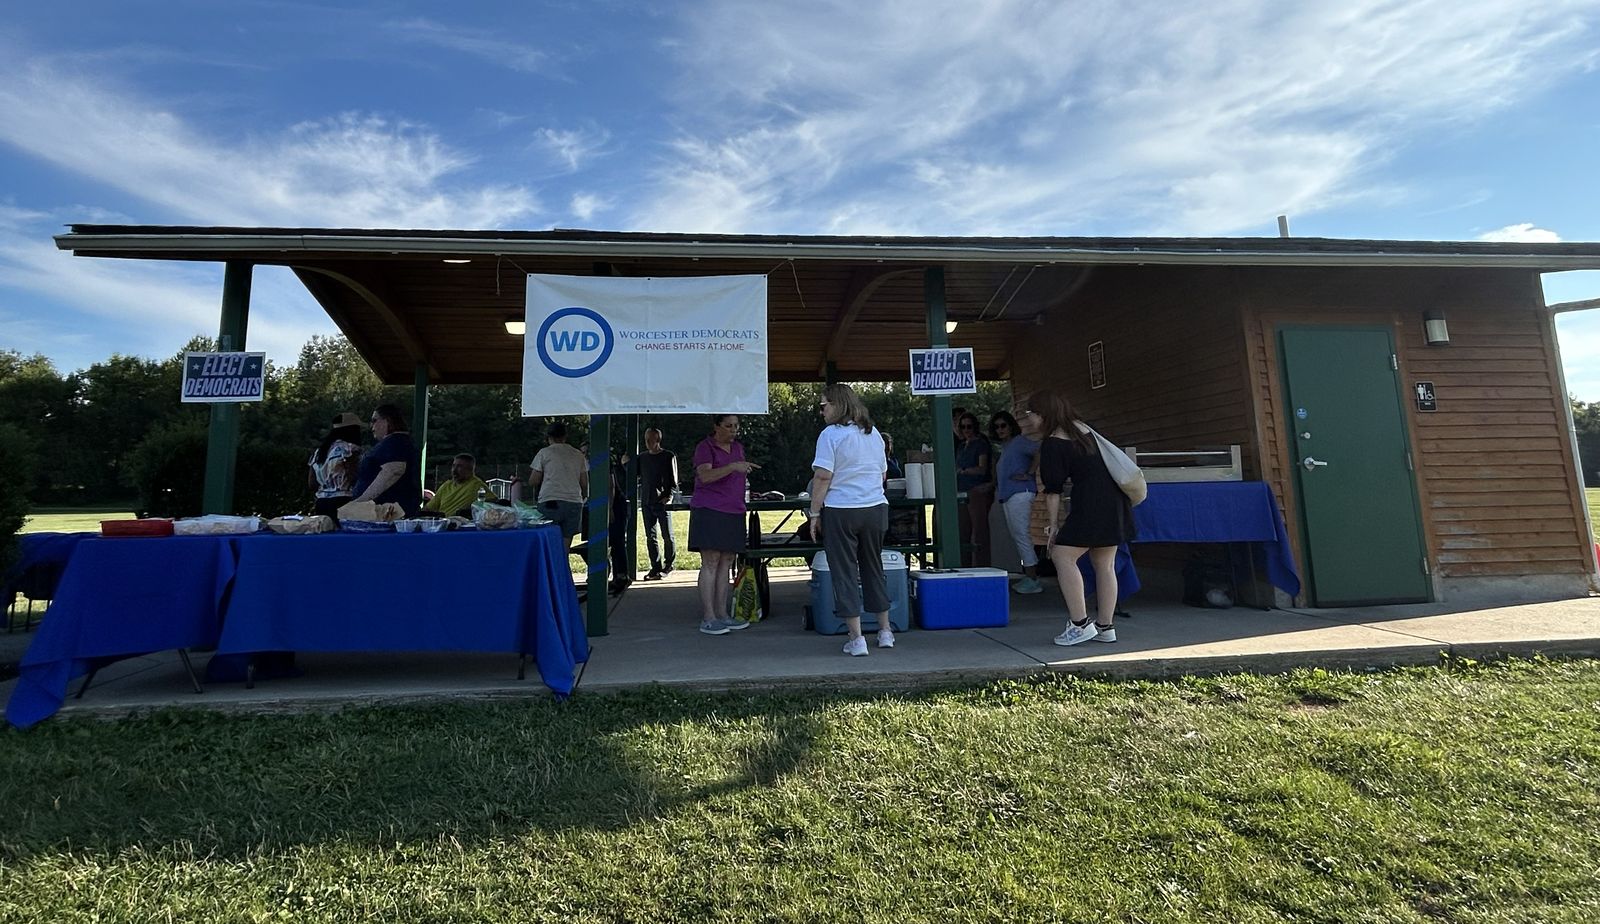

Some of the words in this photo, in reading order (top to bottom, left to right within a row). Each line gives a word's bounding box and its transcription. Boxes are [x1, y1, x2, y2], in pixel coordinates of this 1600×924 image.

[550, 331, 600, 352] WD
[619, 330, 689, 340] WORCESTER
[692, 329, 759, 340] DEMOCRATS
[635, 343, 671, 351] CHANGE
[673, 342, 706, 350] STARTS
[708, 343, 718, 351] AT
[720, 343, 745, 351] HOME
[201, 354, 248, 376] ELECT
[924, 351, 960, 370] ELECT
[184, 378, 262, 395] DEMOCRATS
[914, 371, 973, 388] DEMOCRATS
